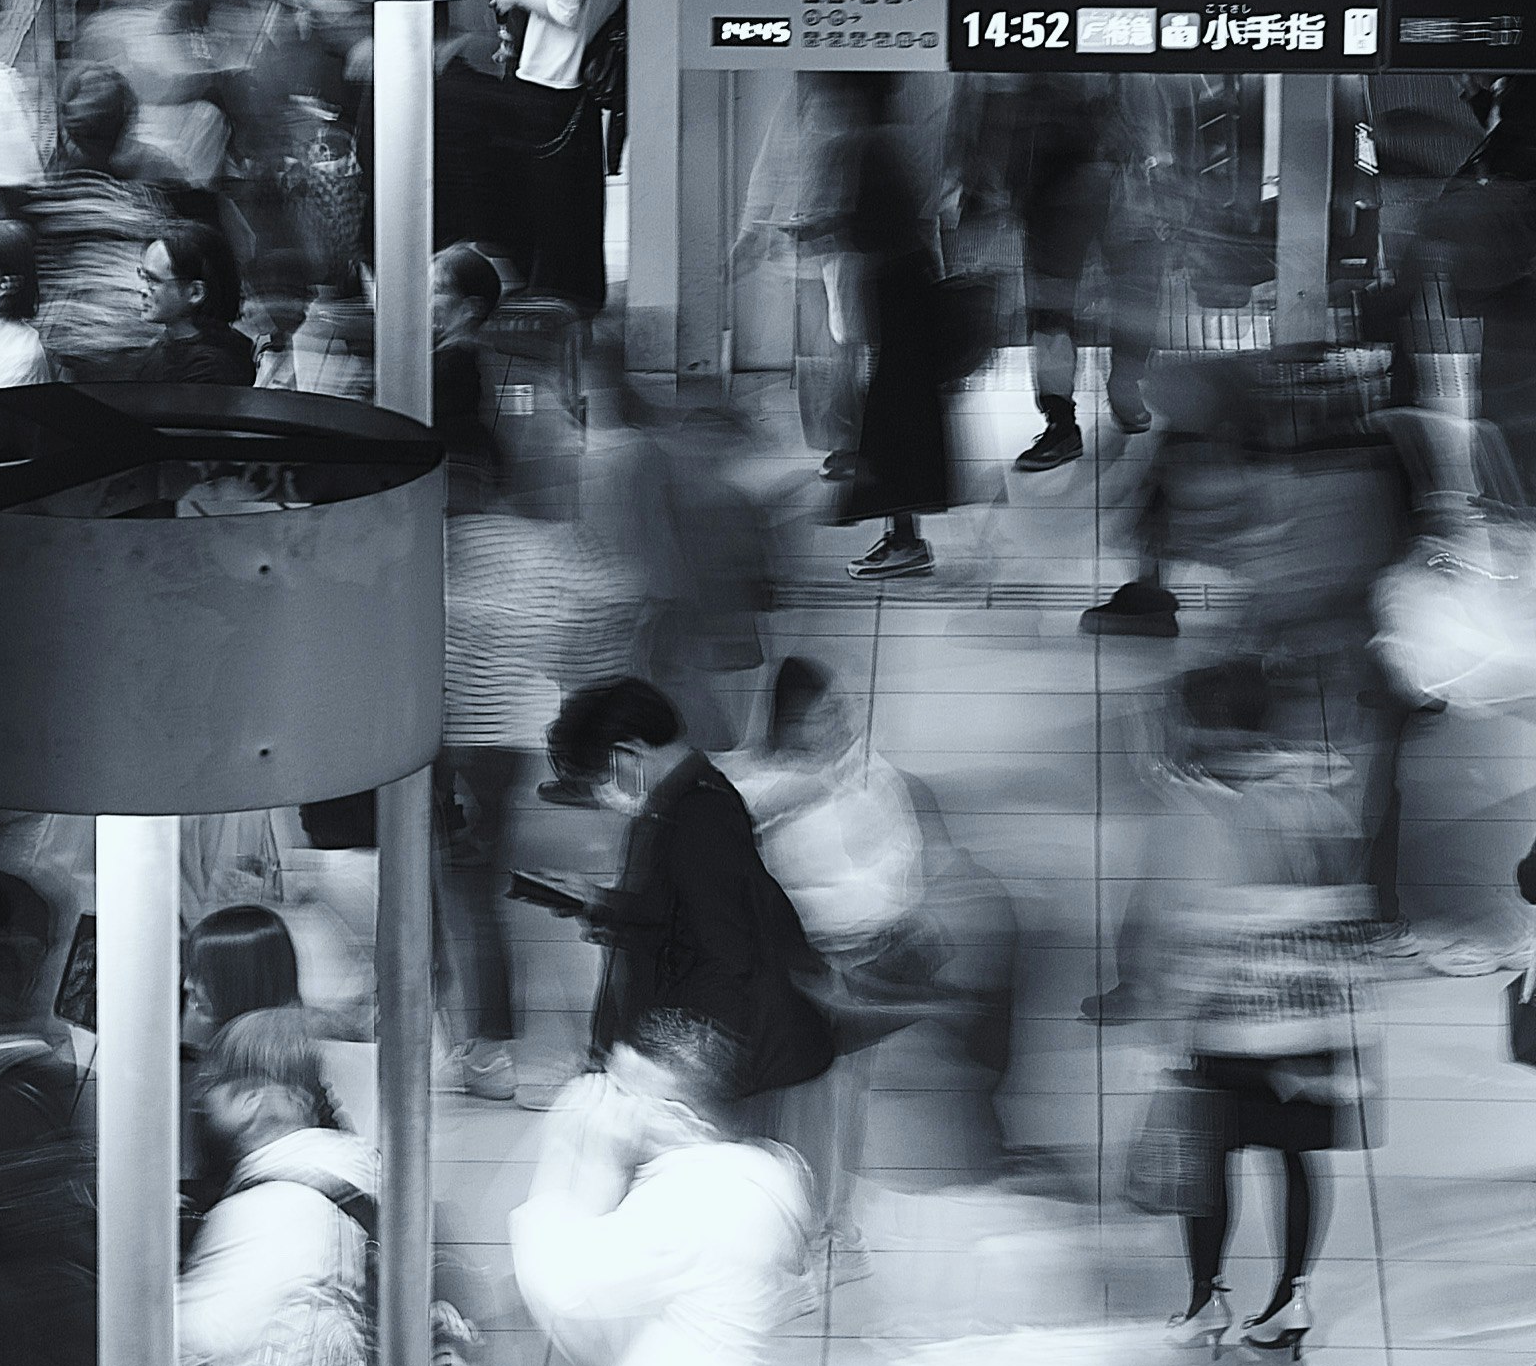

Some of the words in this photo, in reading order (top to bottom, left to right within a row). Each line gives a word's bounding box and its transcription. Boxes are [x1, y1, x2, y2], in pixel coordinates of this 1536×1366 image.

[962, 11, 1070, 48] 14:52
[1202, 13, 1326, 51] 小手指
